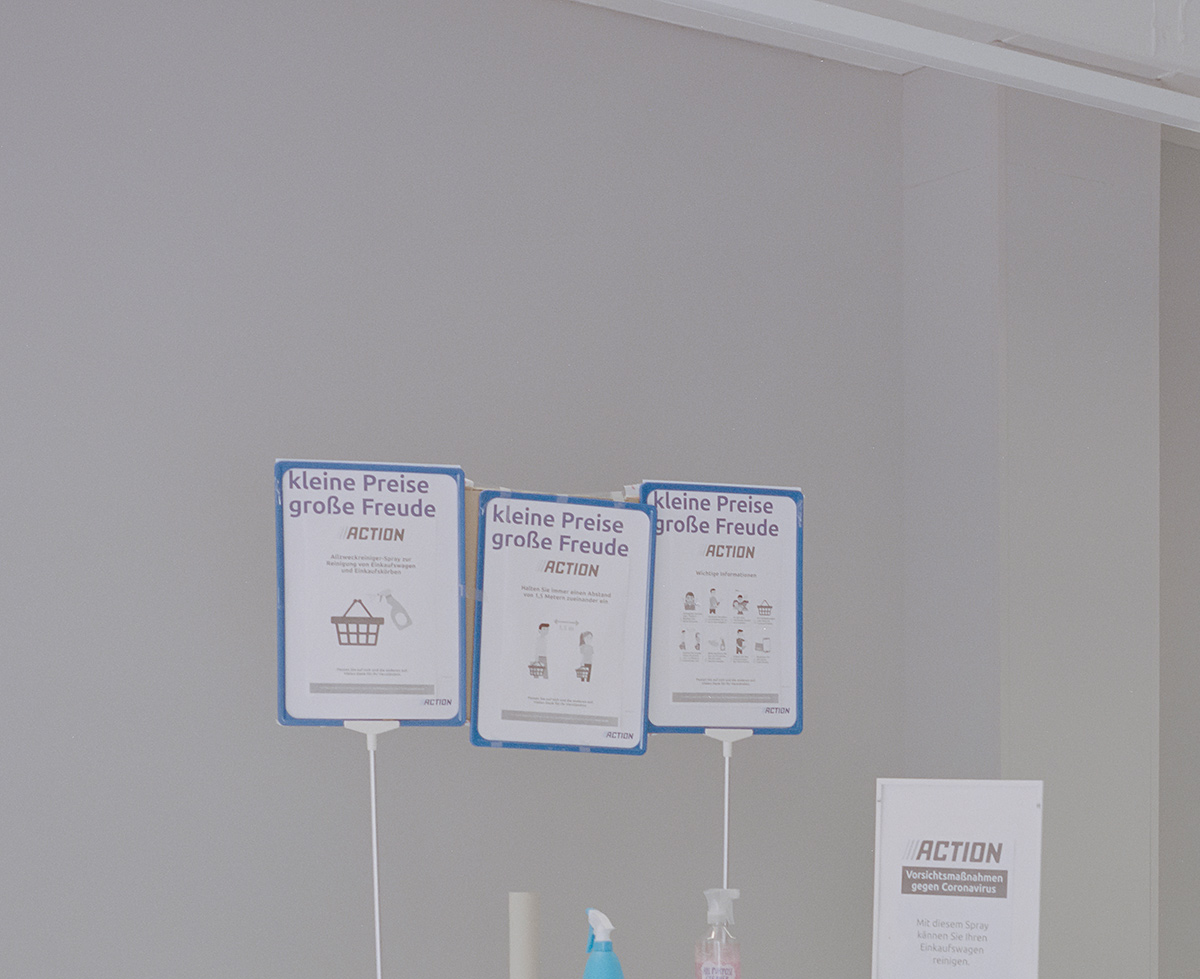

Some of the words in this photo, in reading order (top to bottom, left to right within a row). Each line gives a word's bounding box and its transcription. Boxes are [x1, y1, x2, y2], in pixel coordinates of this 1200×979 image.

[289, 470, 355, 491] kleine
[363, 474, 429, 494] Preise
[289, 495, 355, 518] große
[362, 498, 436, 518] Freude
[654, 491, 711, 511] kleine
[717, 495, 773, 514] Preise
[493, 504, 555, 527] kleine
[562, 512, 624, 533] Preise
[656, 515, 710, 536] große
[716, 518, 779, 537] Freude
[346, 526, 405, 541] ACTION
[492, 530, 552, 550] große
[560, 535, 629, 557] Freude
[705, 544, 755, 559] ACTION
[544, 560, 599, 577] ACTION
[606, 731, 634, 740] ACTION
[916, 840, 1003, 863] ACTION
[905, 869, 1004, 883] Vorsichtsmaßnahmen
[911, 882, 939, 892] gegen
[941, 882, 997, 894] Coronavirus
[916, 918, 930, 928] Mit
[932, 918, 963, 929] diesem
[965, 920, 989, 931] Spray
[917, 930, 948, 940] können
[950, 932, 963, 941] Sie
[965, 933, 988, 942] Ihren
[920, 943, 984, 955] Einkaufswagen
[933, 956, 970, 967] reinigen.
